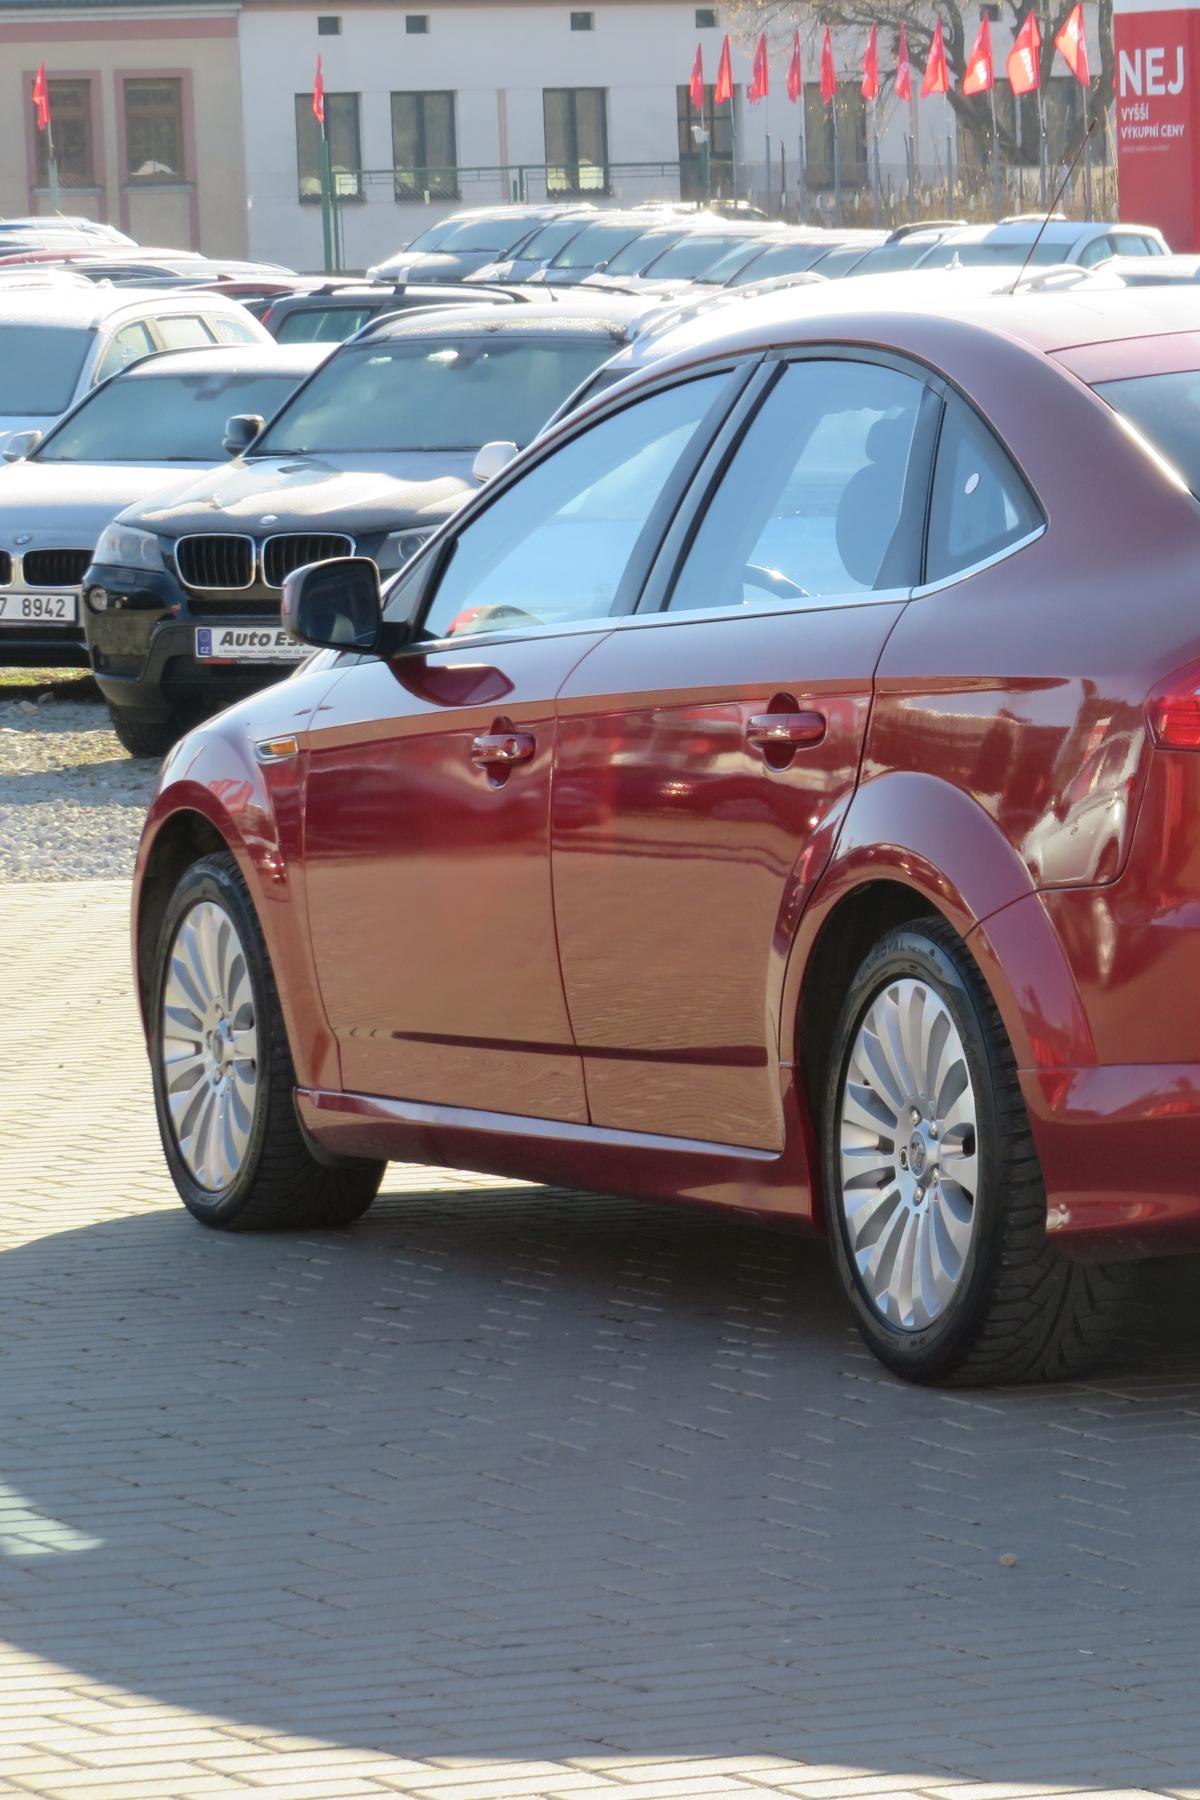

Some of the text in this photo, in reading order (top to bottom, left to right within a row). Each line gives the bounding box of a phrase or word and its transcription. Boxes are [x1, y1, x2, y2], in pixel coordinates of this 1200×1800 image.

[1118, 46, 1184, 97] NEJ
[1121, 102, 1149, 121] VYŠŠÍ
[1121, 122, 1185, 139] VÝKUPNÍ CENY
[22, 598, 66, 618] 8942
[220, 631, 272, 647] Auto
